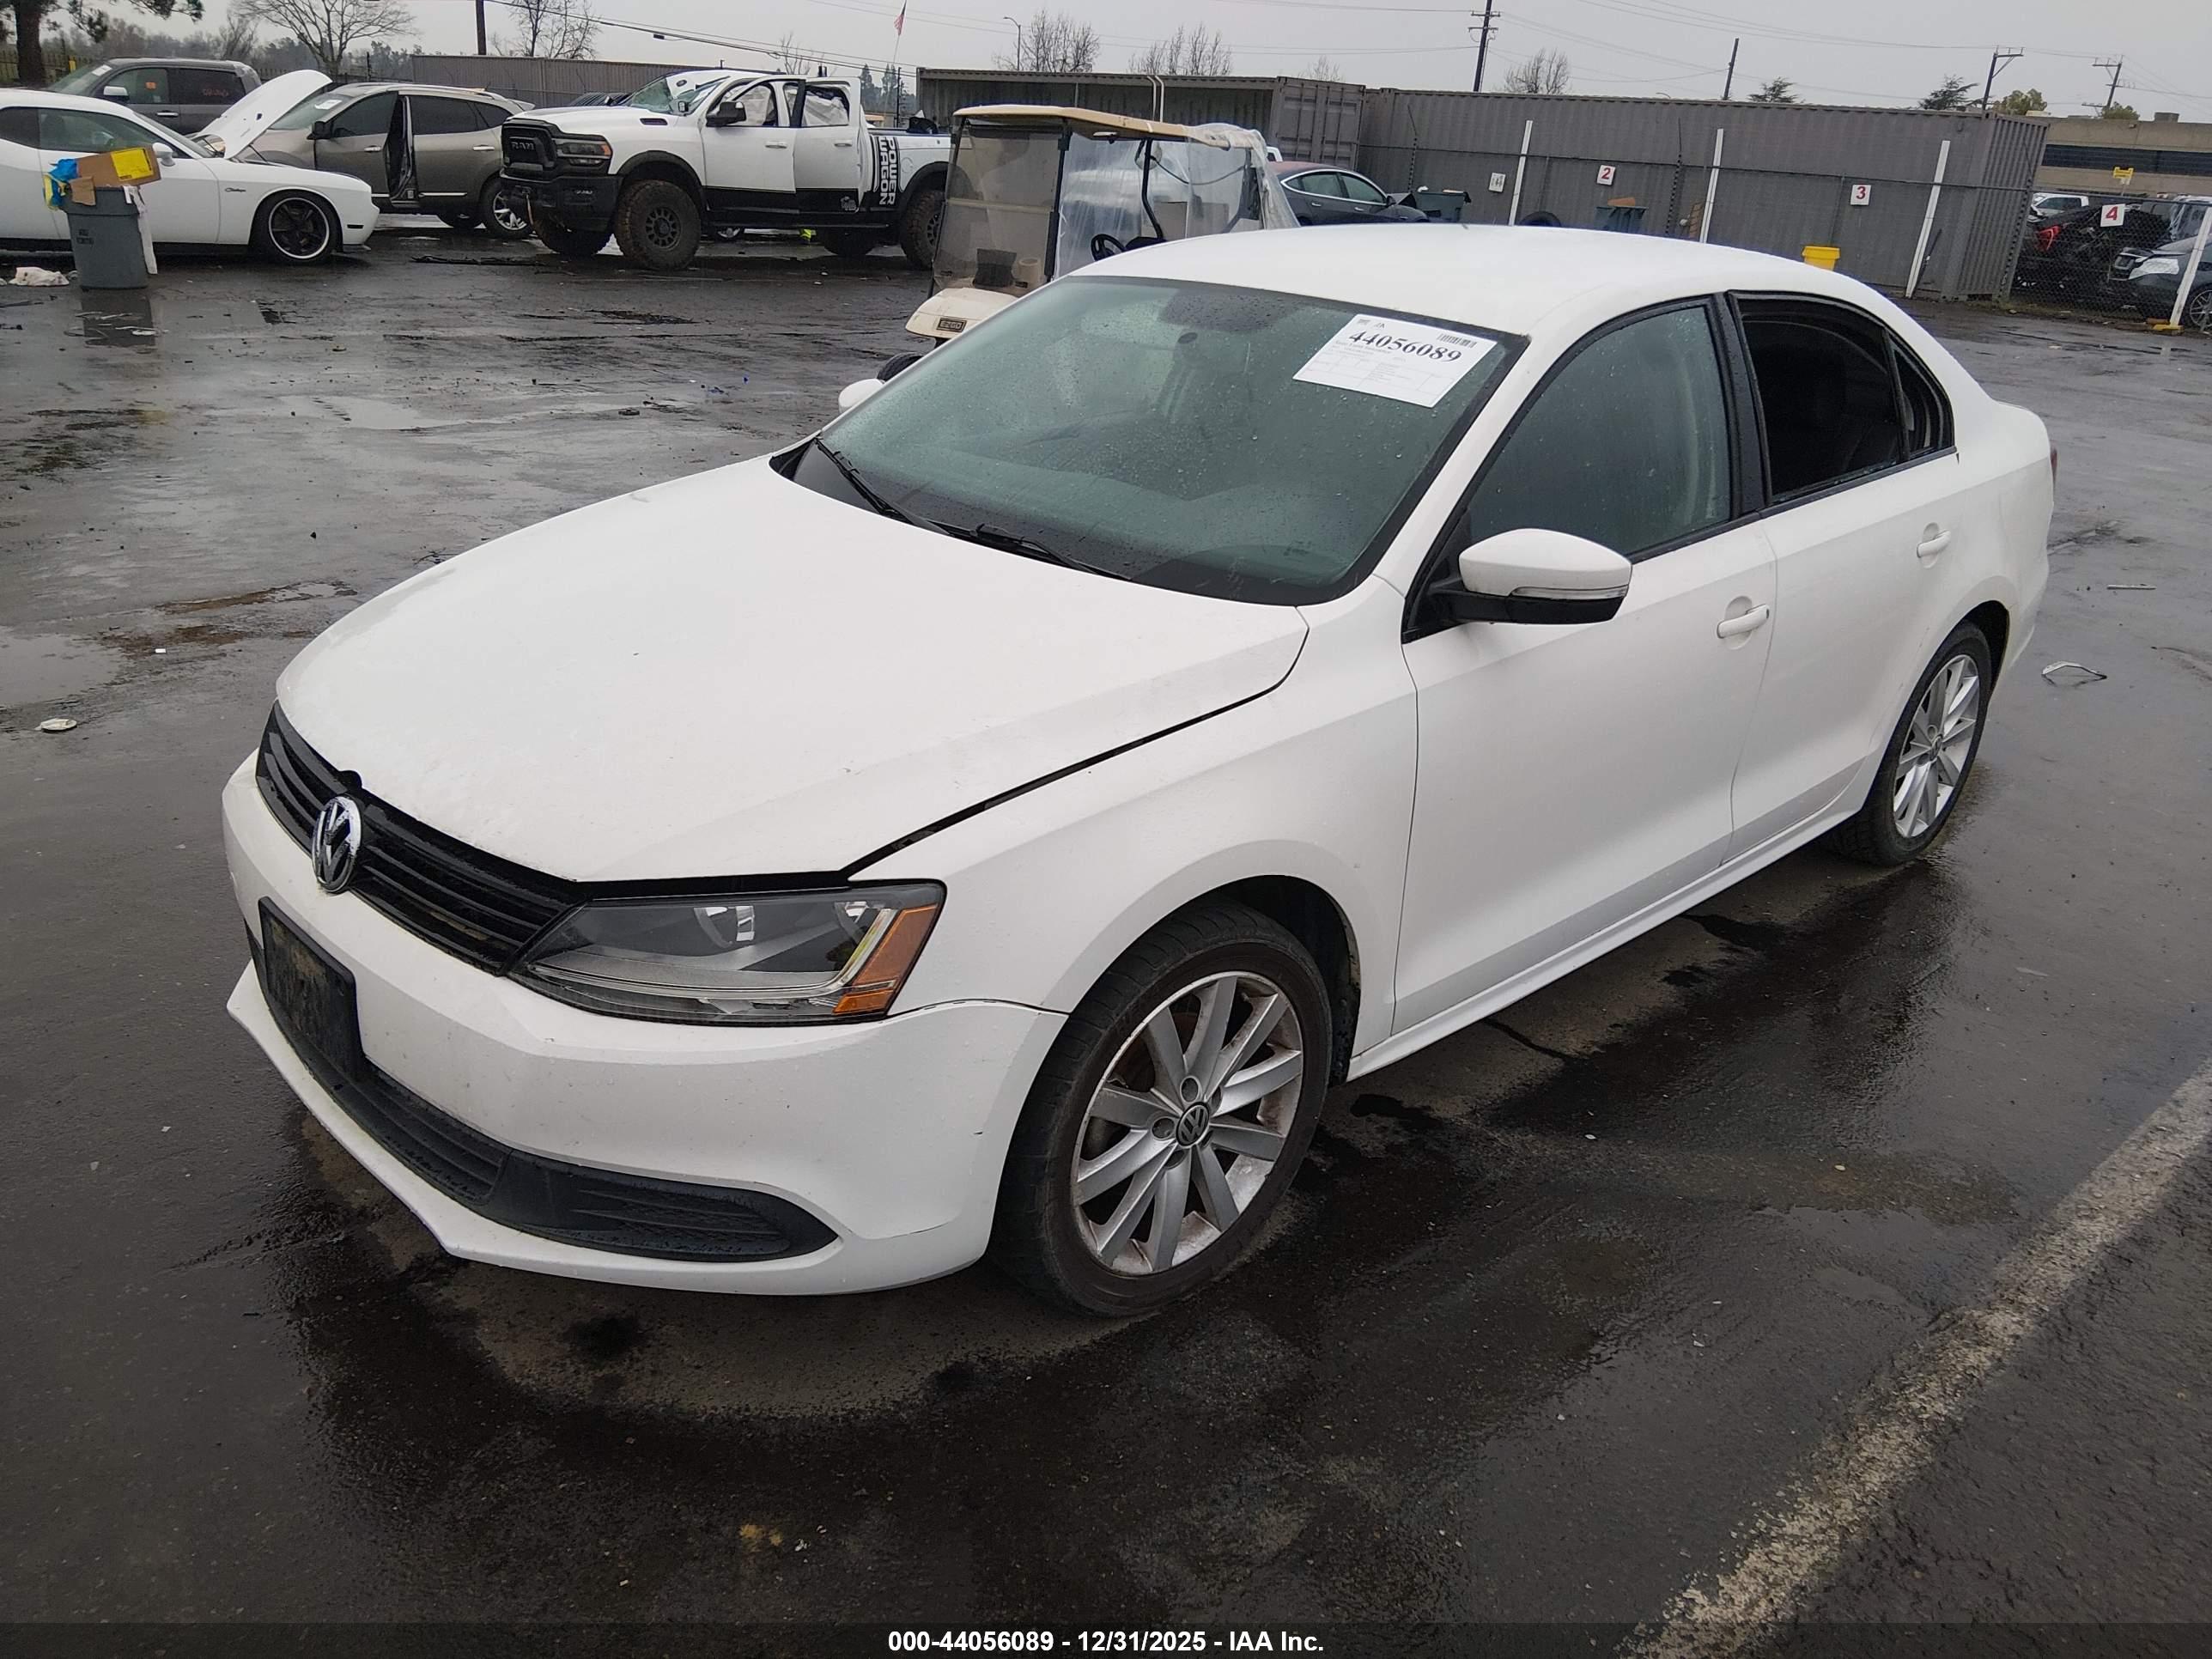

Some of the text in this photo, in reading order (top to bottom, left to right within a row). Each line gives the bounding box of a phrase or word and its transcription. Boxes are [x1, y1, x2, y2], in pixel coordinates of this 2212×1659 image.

[878, 137, 890, 205] WAGON
[886, 137, 897, 205] POWER
[1601, 167, 1611, 179] 2
[1856, 185, 1866, 200] 3
[2106, 206, 2118, 221] 4
[1349, 330, 1462, 363] 44056089
